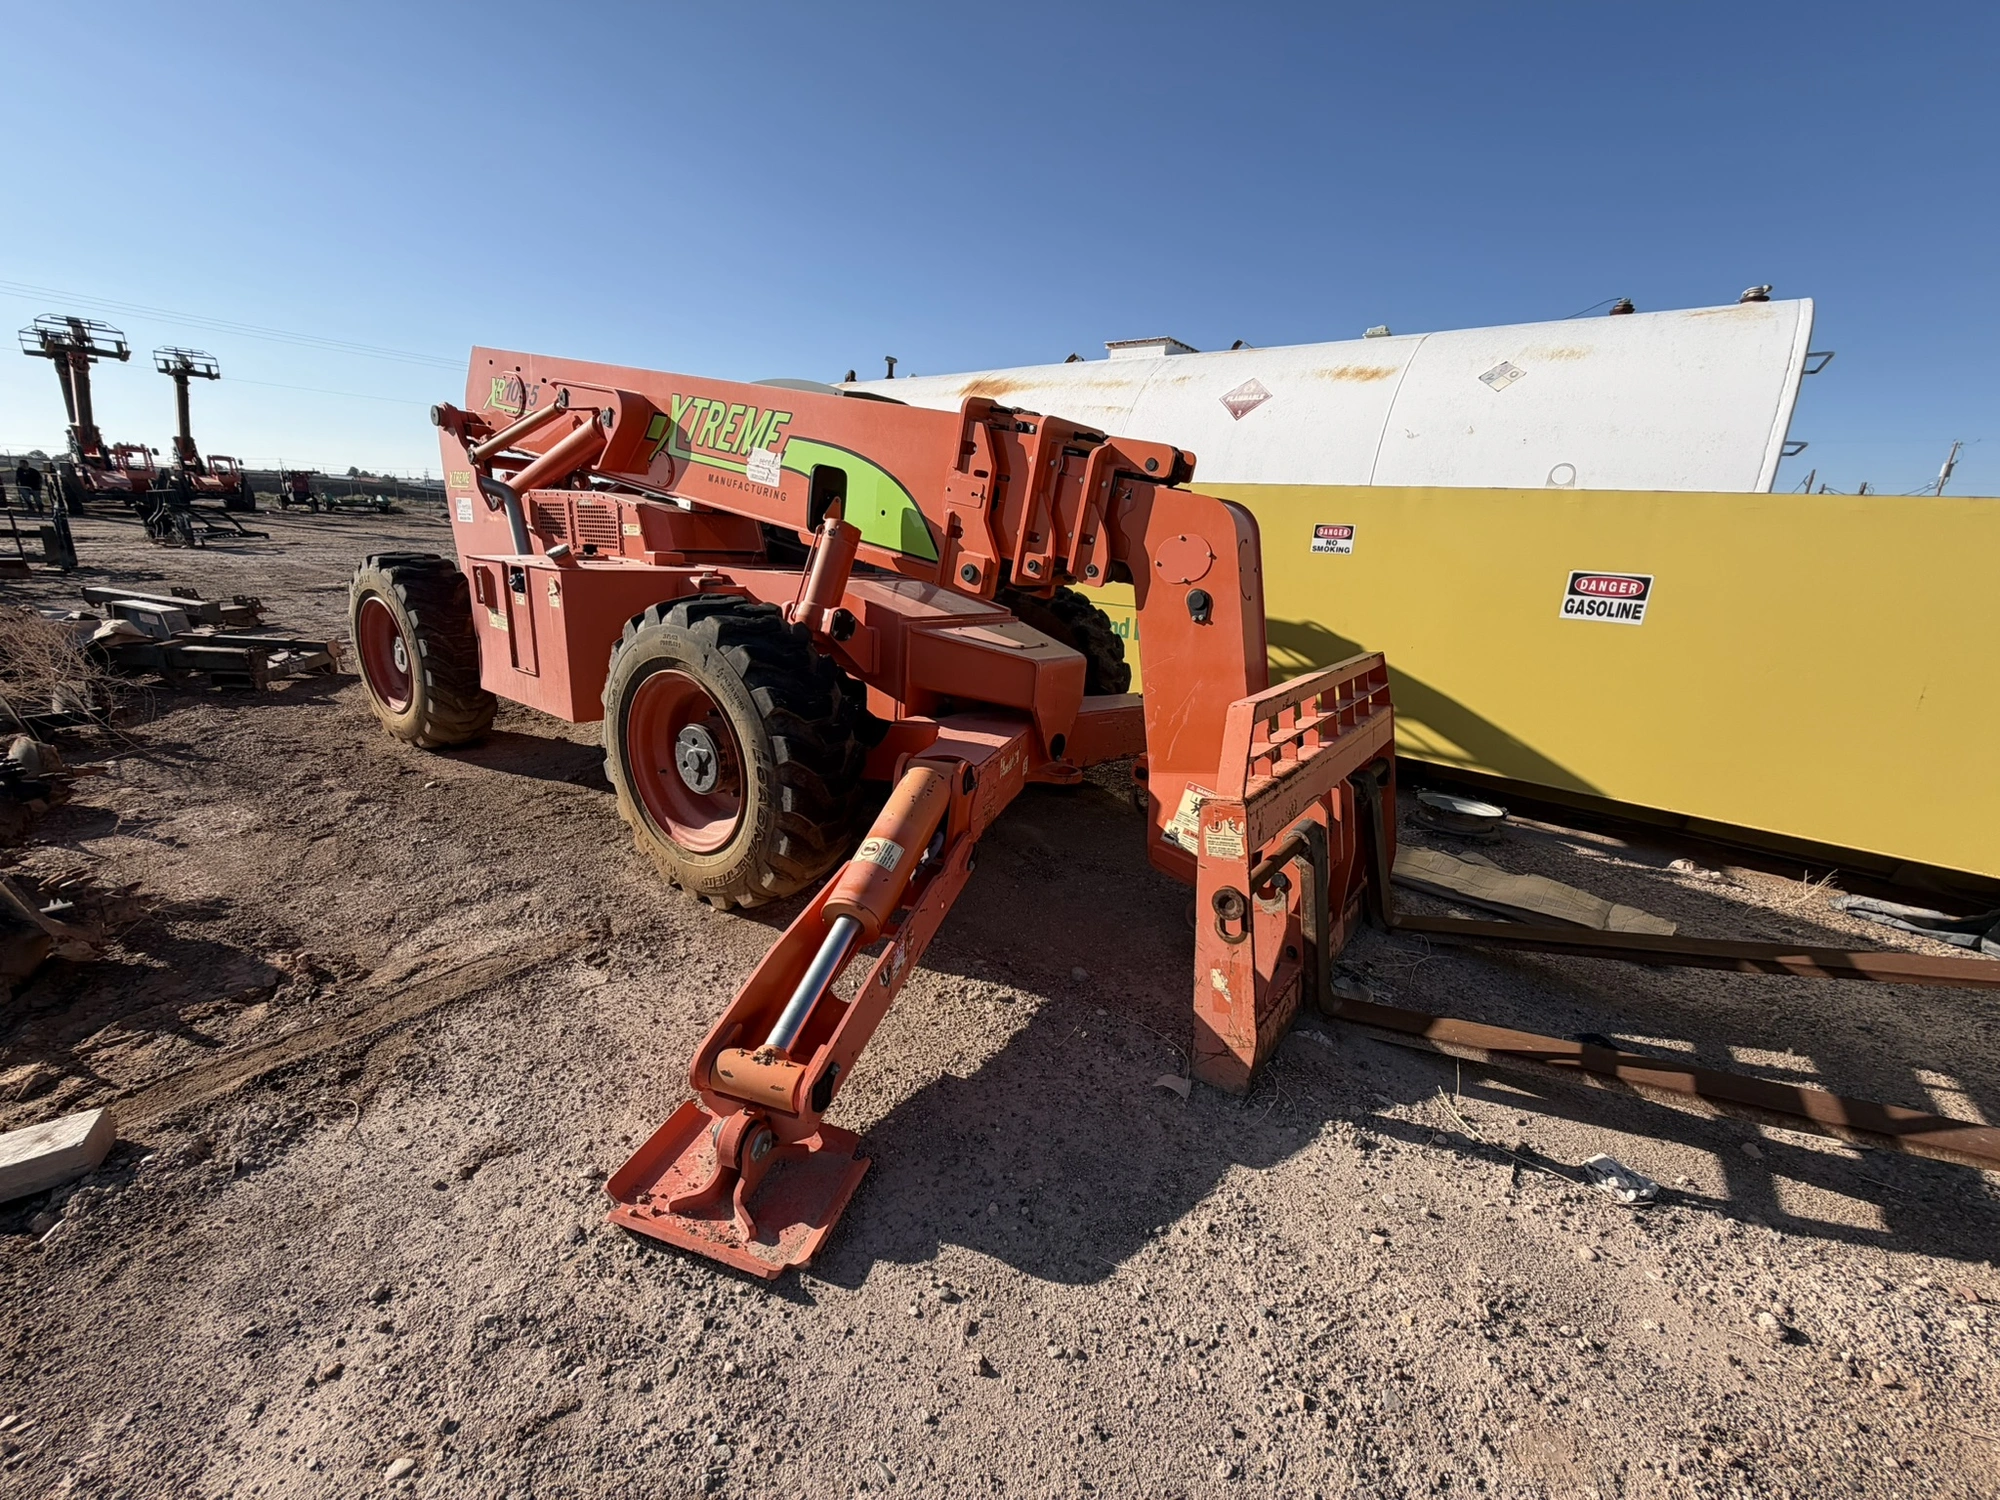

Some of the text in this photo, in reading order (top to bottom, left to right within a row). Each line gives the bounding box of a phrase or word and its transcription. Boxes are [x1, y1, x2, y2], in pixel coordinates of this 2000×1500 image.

[647, 393, 793, 462] XTREME
[707, 473, 788, 502] MANUFACTURING
[1319, 528, 1349, 536] DANGER
[1312, 545, 1351, 554] SMOKING
[1325, 539, 1338, 547] NO
[1579, 579, 1638, 594] DANGER
[1563, 598, 1645, 620] GASOLINE
